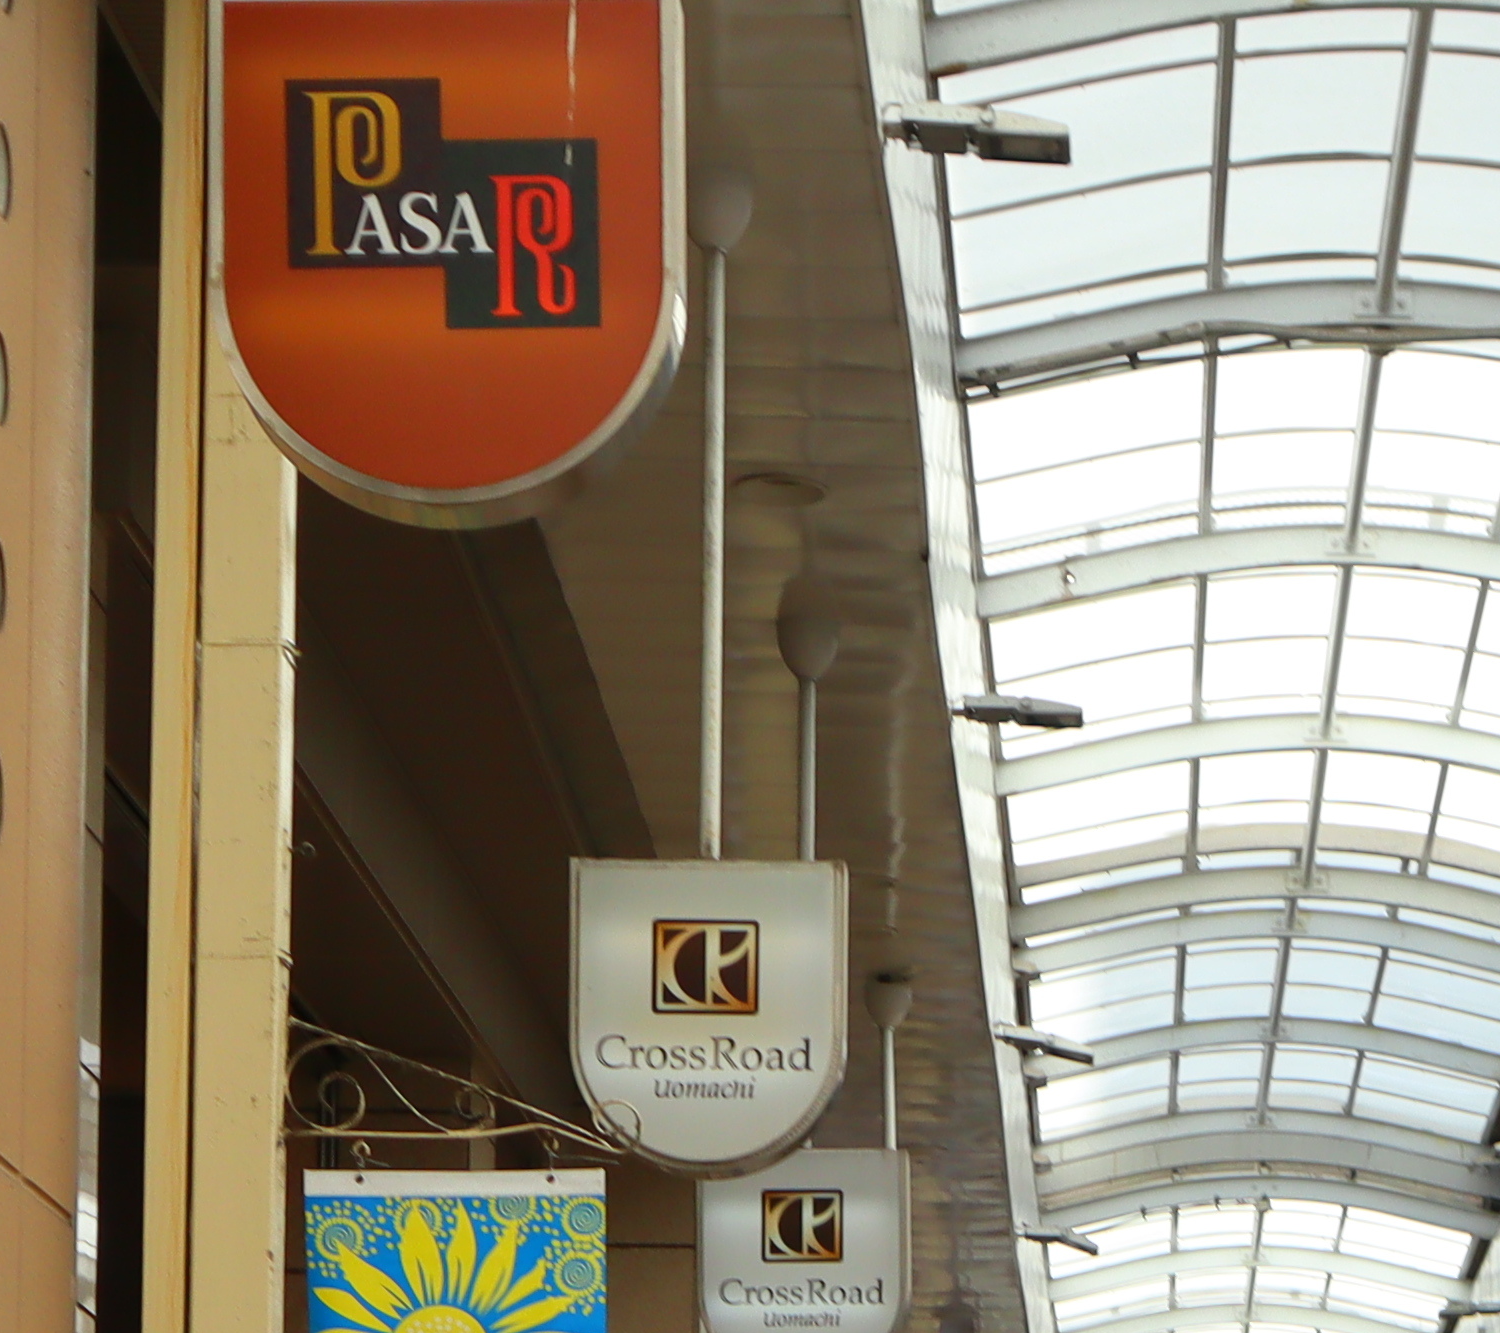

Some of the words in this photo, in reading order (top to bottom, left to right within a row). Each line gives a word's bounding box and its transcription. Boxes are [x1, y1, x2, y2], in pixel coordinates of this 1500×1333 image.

[302, 90, 577, 317] PASAR
[653, 1076, 756, 1100] Uomachi
[764, 1310, 842, 1331] Uomachi
